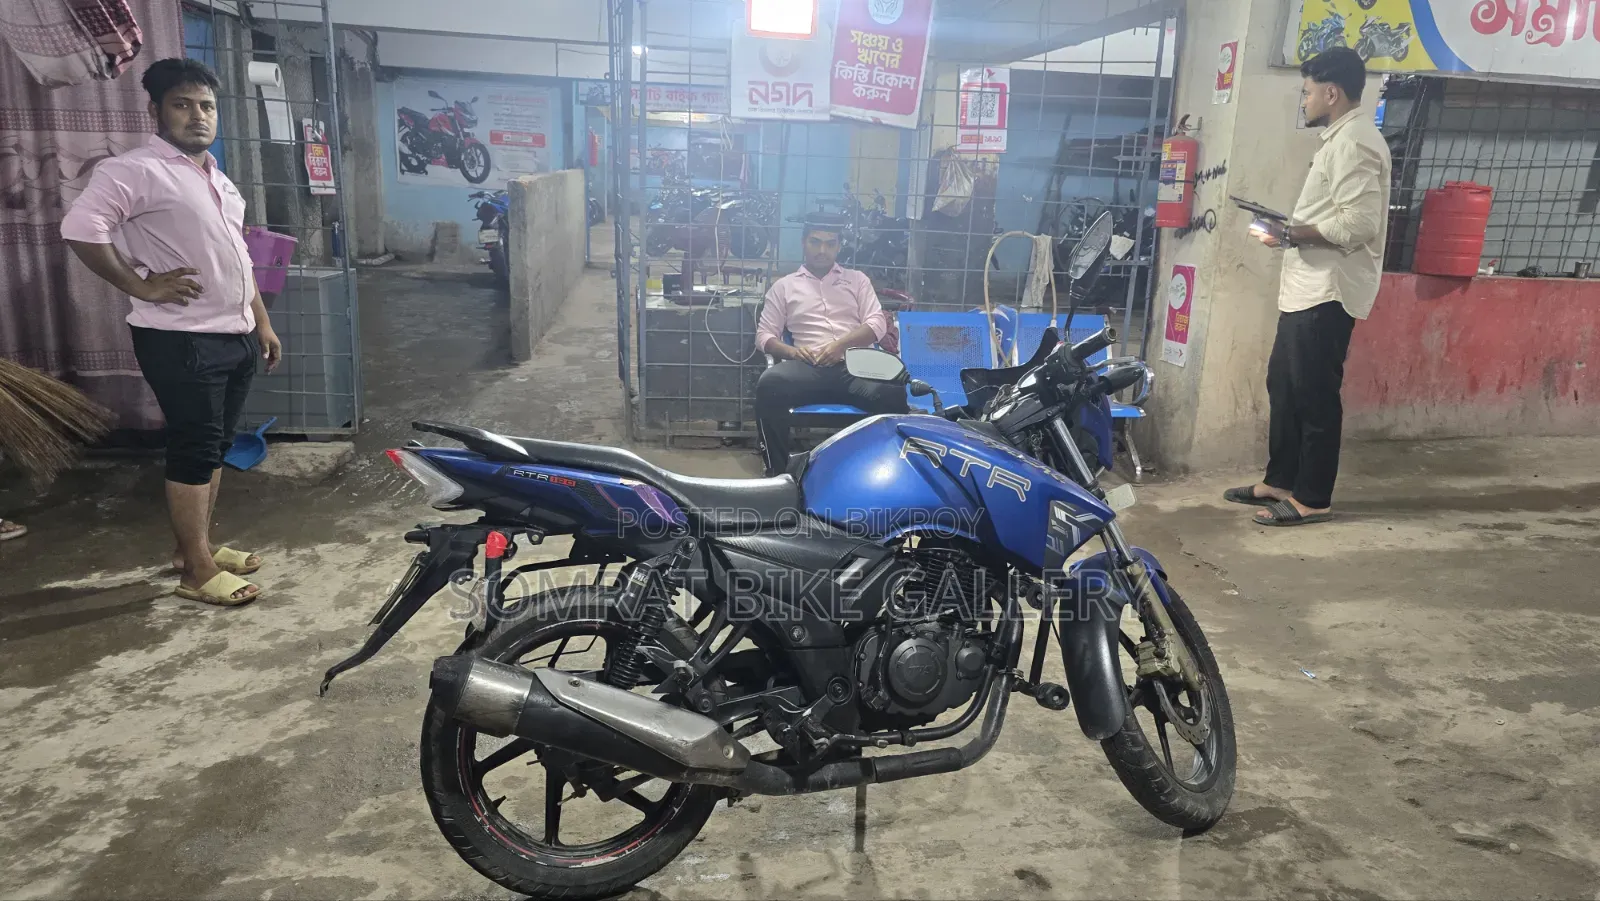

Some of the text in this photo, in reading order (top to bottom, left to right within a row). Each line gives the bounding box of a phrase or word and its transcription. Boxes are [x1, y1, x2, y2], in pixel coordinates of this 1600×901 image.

[892, 37, 903, 53] ও
[857, 47, 902, 69] ঋণের
[834, 60, 917, 90] কিস্তি বিকাশ
[747, 80, 814, 108] নগদ
[852, 82, 892, 102] করুন
[513, 469, 549, 481] RTR
[899, 436, 1032, 502] RTR
